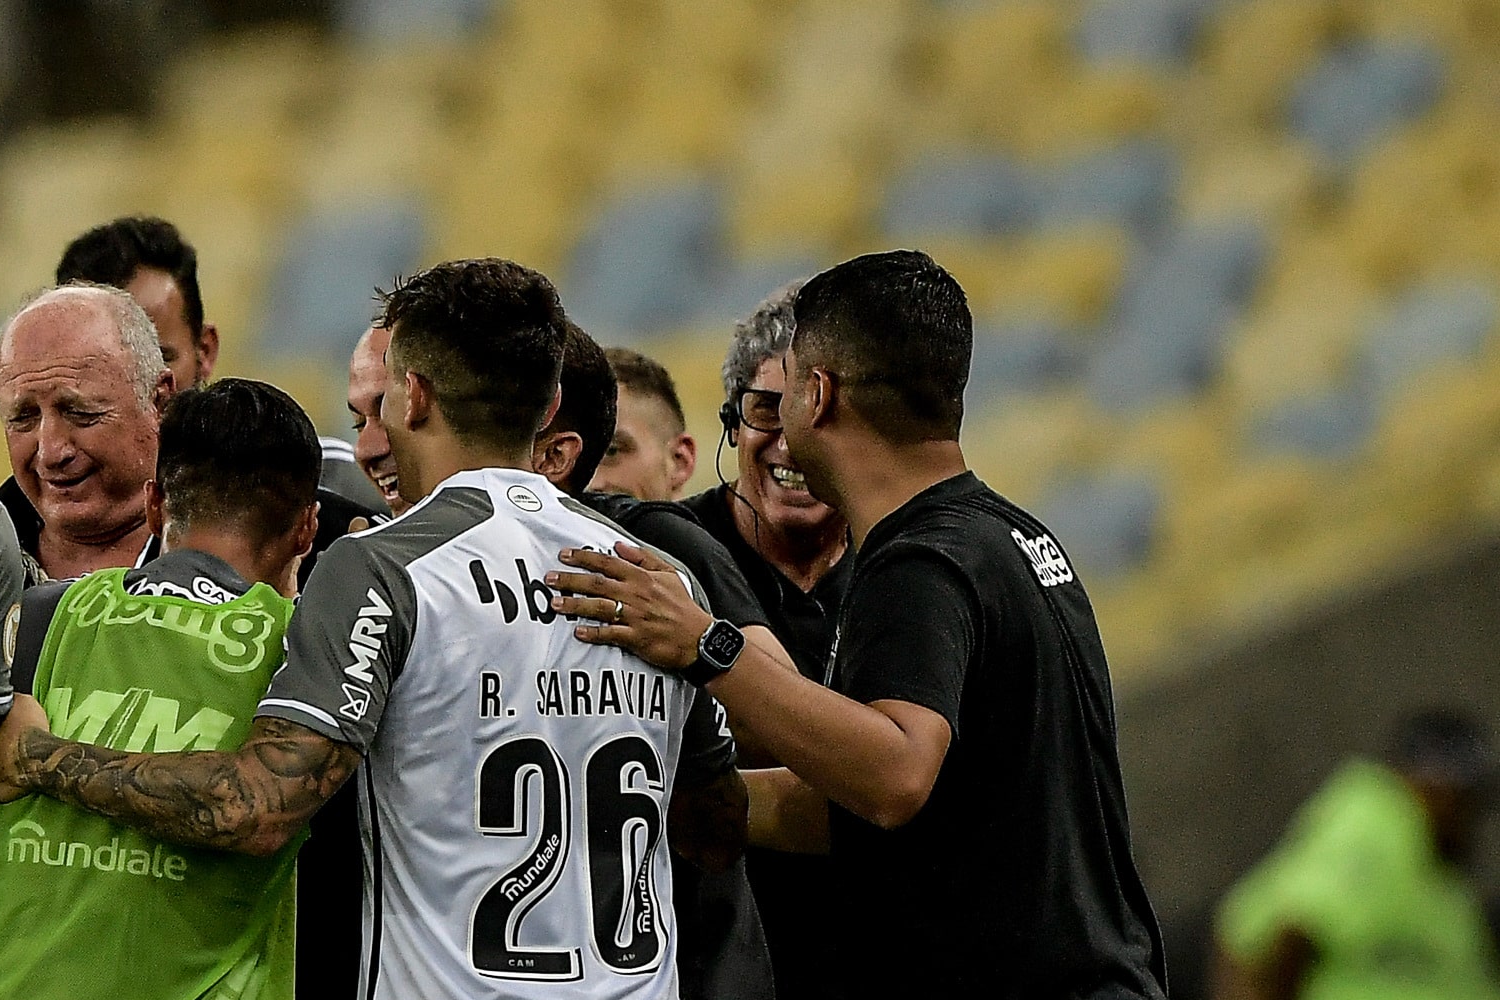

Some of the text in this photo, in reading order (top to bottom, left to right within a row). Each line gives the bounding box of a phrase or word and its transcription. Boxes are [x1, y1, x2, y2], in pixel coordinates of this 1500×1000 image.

[102, 579, 276, 673] bmg
[345, 588, 393, 684] MRV
[480, 670, 516, 718] R.
[6, 827, 189, 881] mundiale
[469, 734, 668, 983] 26
[500, 833, 560, 902] mundiale
[508, 958, 535, 968] CAM
